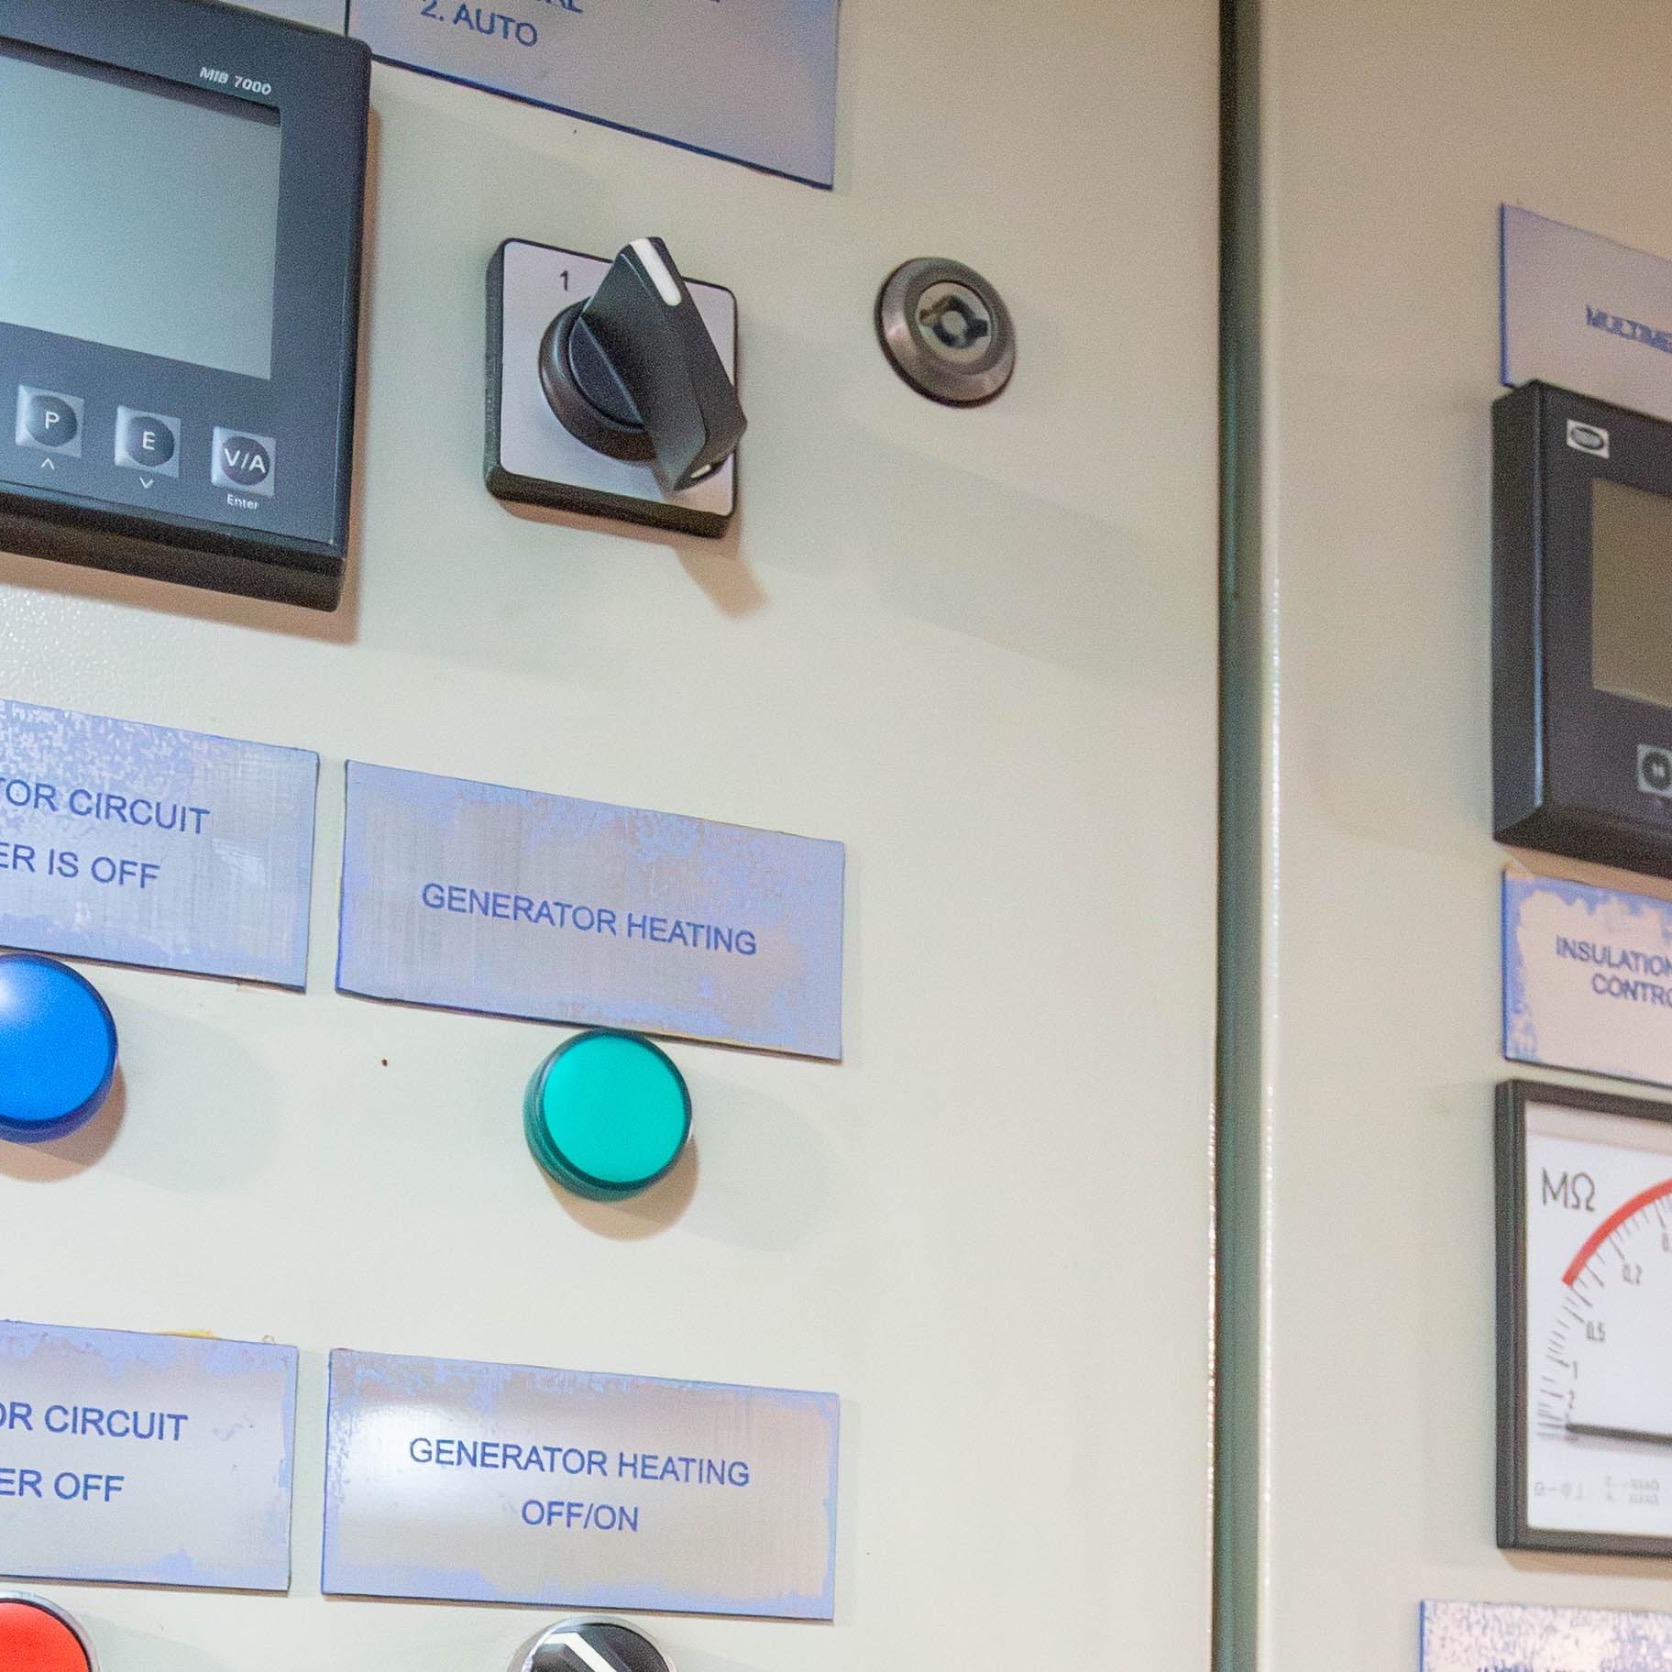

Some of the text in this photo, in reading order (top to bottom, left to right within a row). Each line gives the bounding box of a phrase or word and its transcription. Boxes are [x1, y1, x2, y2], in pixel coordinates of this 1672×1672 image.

[453, 3, 538, 47] AUTO
[233, 74, 272, 96] 7000
[560, 270, 570, 290] 1
[45, 411, 60, 430] P
[143, 432, 156, 450] E
[224, 448, 266, 473] V/A
[227, 494, 260, 511] Enter
[69, 789, 211, 835] CIRCUIT
[49, 849, 79, 877] IS
[91, 856, 160, 890] OFF
[422, 883, 757, 955] GENERATOR HEATING
[1541, 1168, 1596, 1211] MΩ
[44, 1405, 188, 1441] CIRCUIT
[409, 1437, 750, 1487] GENERATOR HEATING
[54, 1472, 125, 1502] OFF
[521, 1499, 639, 1532] OFF/ON
